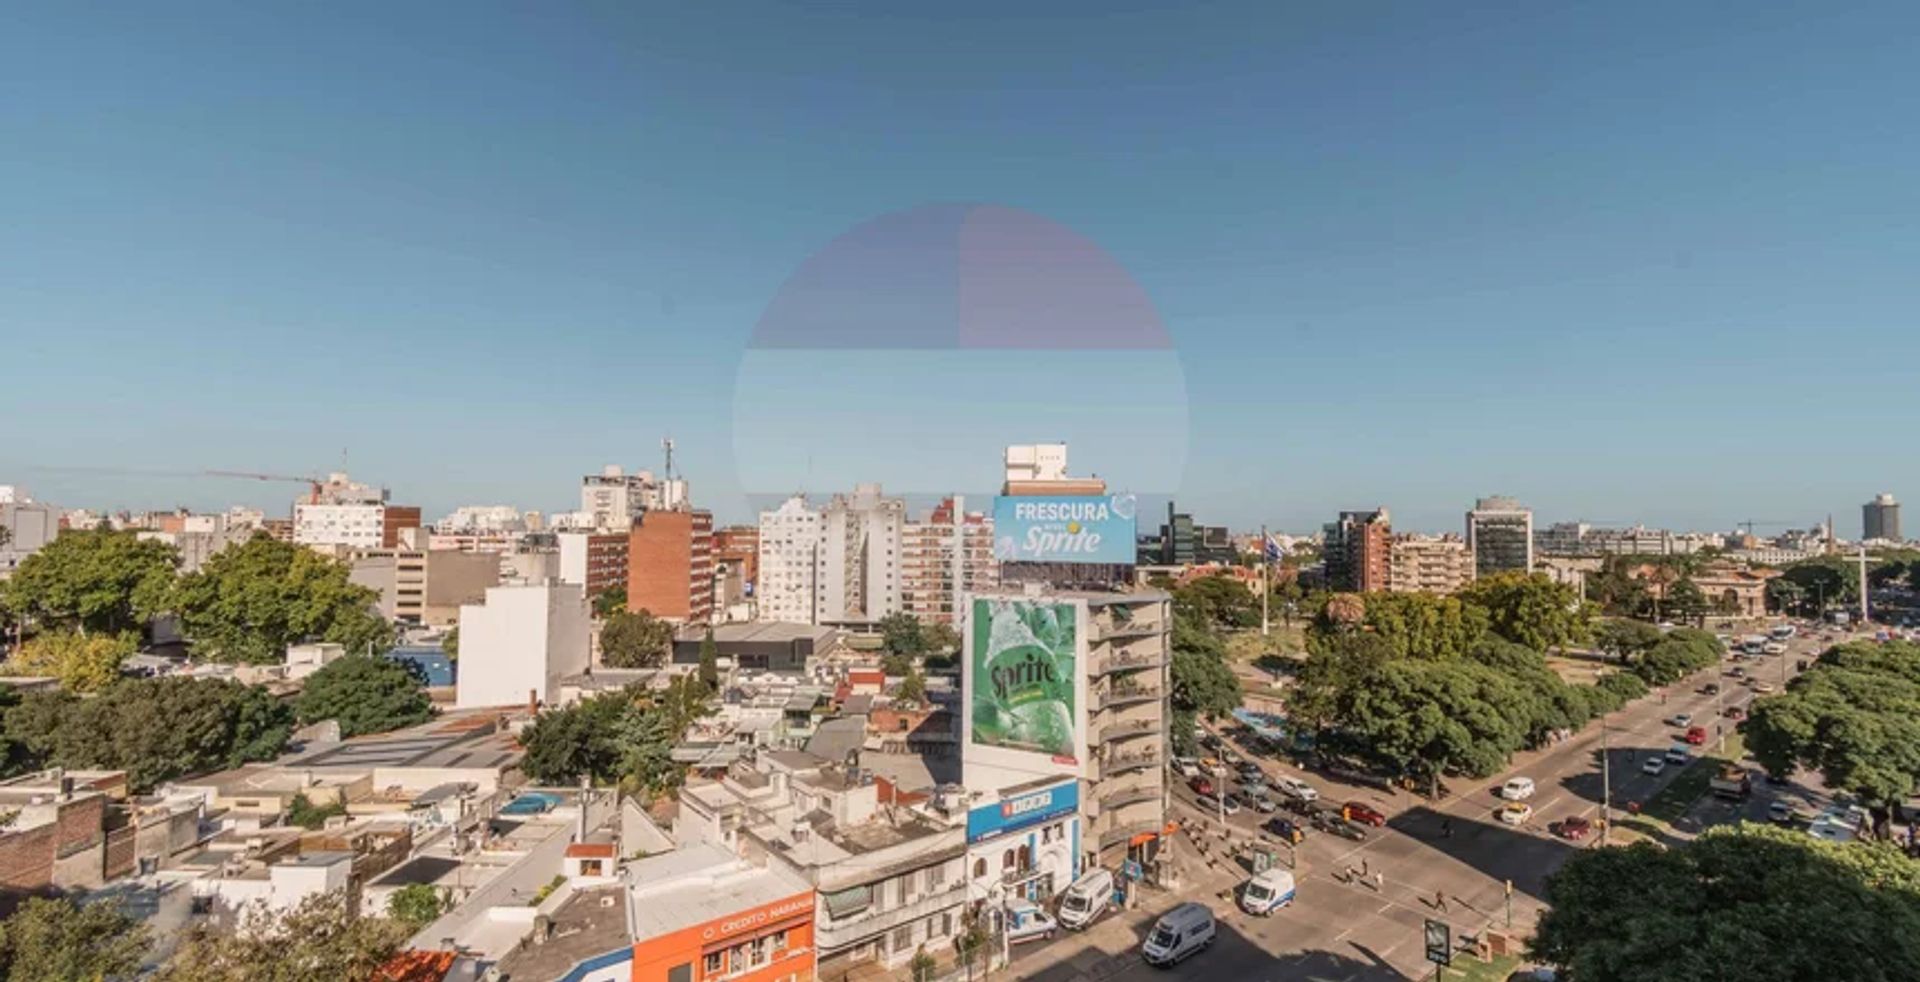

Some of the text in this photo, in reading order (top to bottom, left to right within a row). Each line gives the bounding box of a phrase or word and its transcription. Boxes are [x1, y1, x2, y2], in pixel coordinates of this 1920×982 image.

[1015, 502, 1110, 521] FRESCURA
[1022, 523, 1102, 557] Sprite
[991, 653, 1056, 700] Sprite
